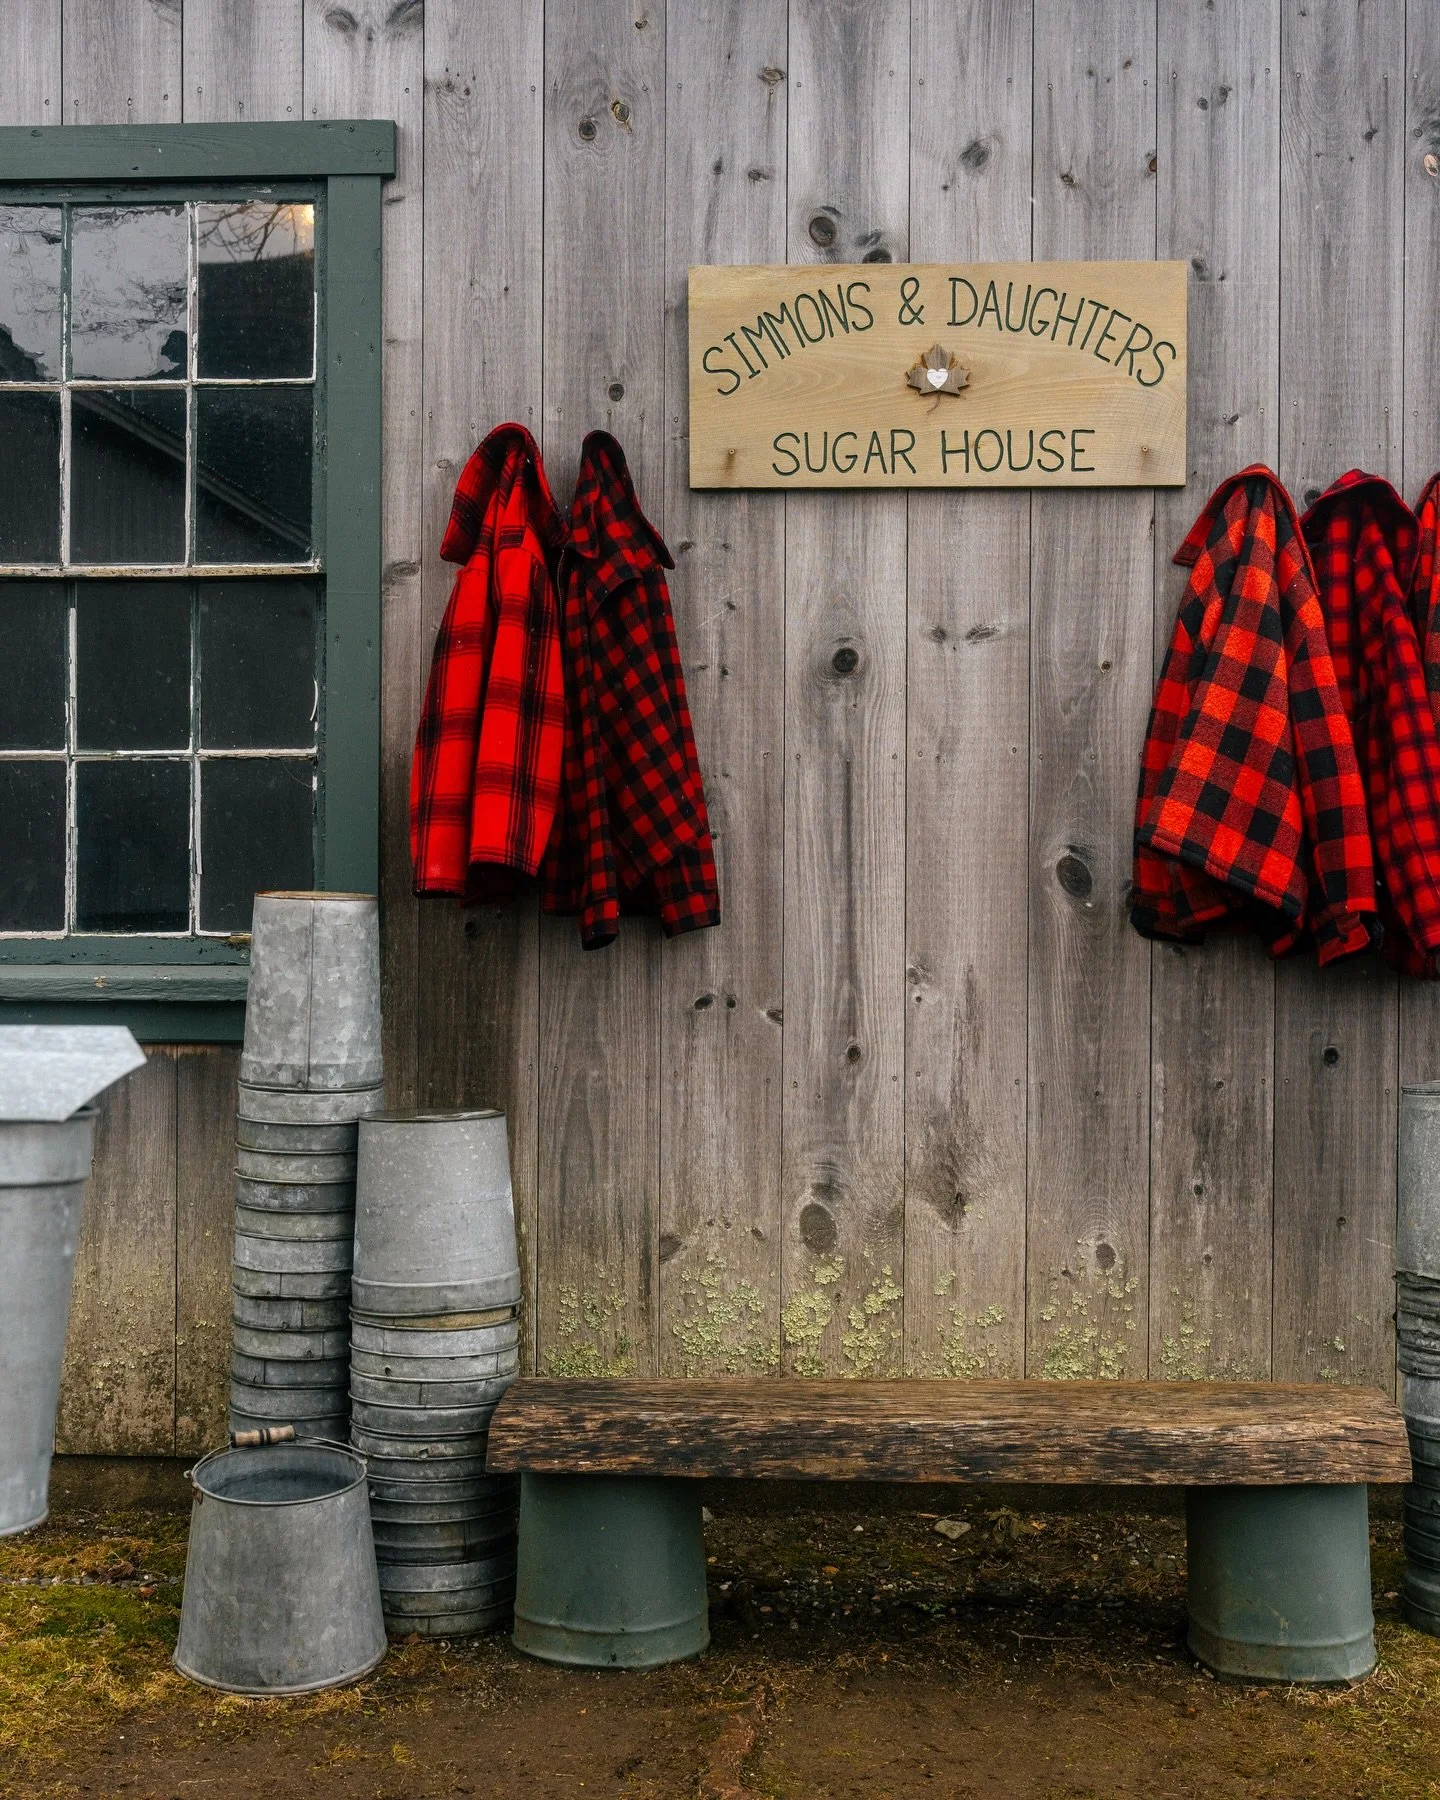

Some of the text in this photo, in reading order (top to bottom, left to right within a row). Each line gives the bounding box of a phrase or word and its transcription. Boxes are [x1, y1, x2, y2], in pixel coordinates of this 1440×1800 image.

[702, 276, 1177, 396] SIMMONS & DAUGHTERS
[772, 429, 1096, 476] SUGAR HOUSE
